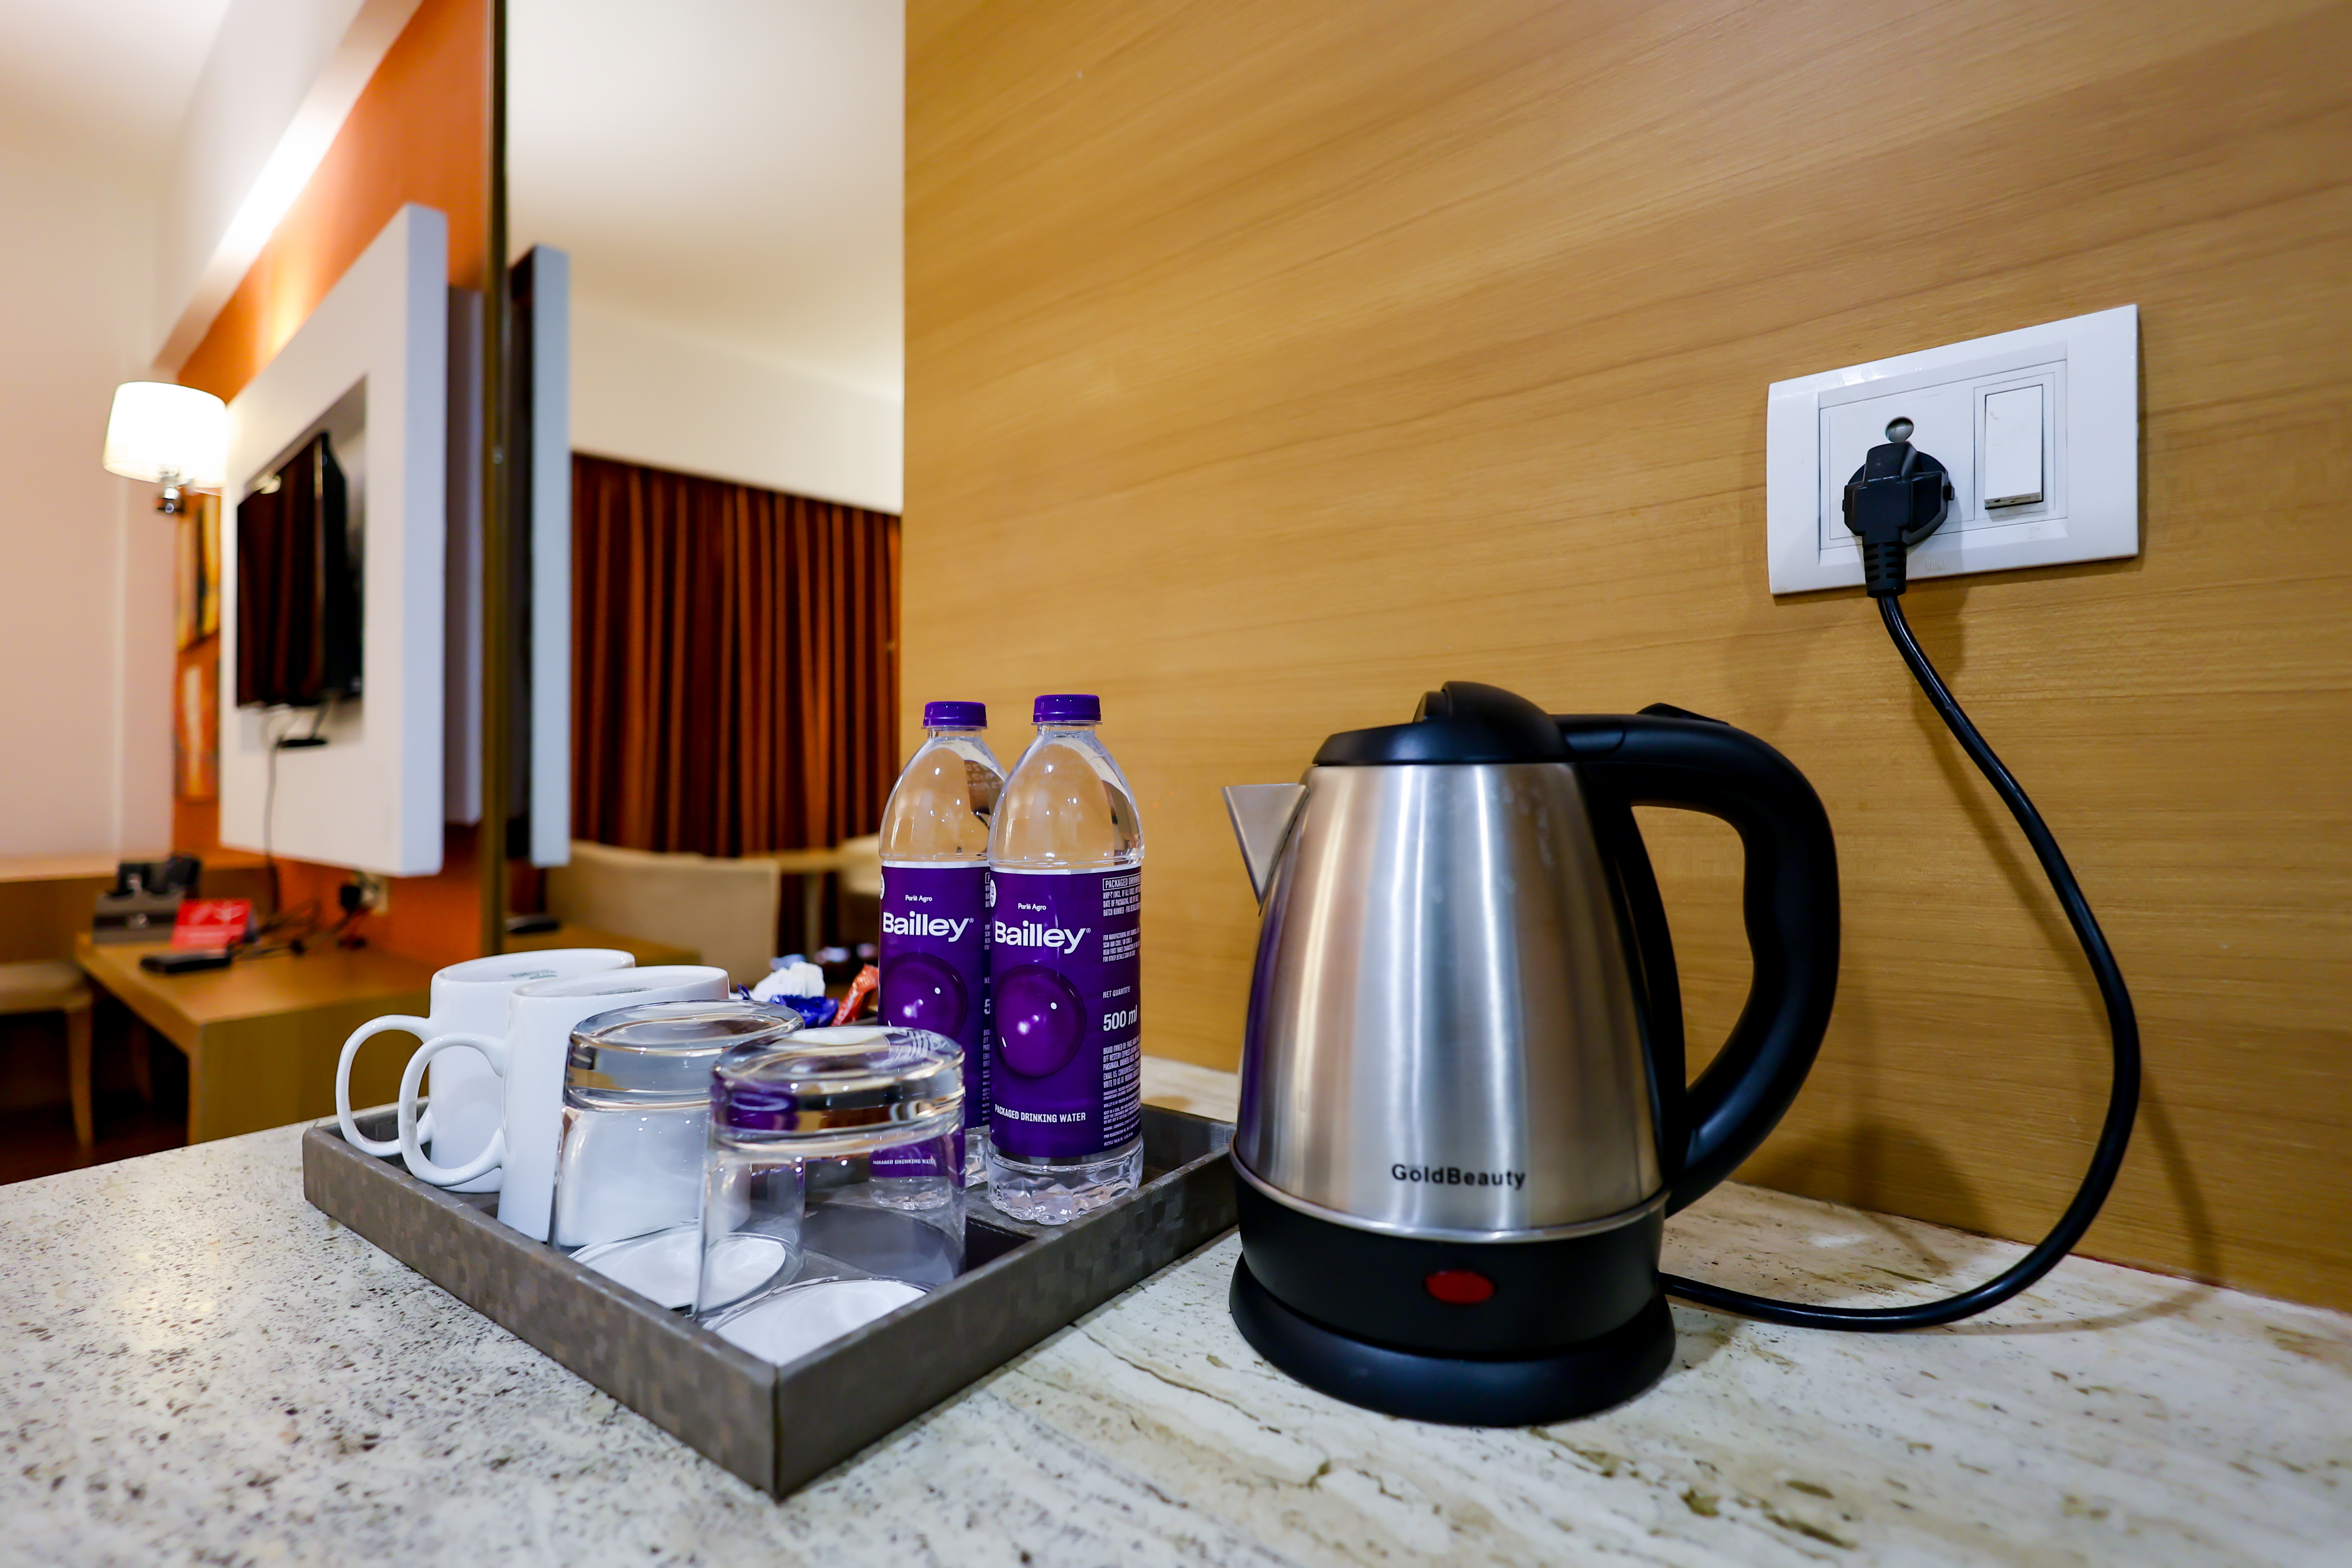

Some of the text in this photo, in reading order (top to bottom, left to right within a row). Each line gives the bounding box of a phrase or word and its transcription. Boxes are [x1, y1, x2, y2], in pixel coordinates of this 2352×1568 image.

[1105, 878, 1128, 888] PACKAGED
[1032, 904, 1047, 912] Agro
[883, 911, 970, 942] Bailley
[995, 920, 1086, 954] Bailley
[1103, 985, 1131, 998] NET QUANTITY:
[1103, 1005, 1138, 1031] 500 ml
[1103, 1046, 1112, 1054] BRAND
[1113, 1044, 1122, 1052] OWNED
[1103, 1071, 1112, 1080] EMAIL
[1103, 1080, 1112, 1088] WRITE
[995, 1103, 1019, 1120] PACKAGED
[1021, 1112, 1057, 1123] DRINKING
[1060, 1112, 1086, 1123] WATER
[1392, 1163, 1526, 1190] GoldBeauty
